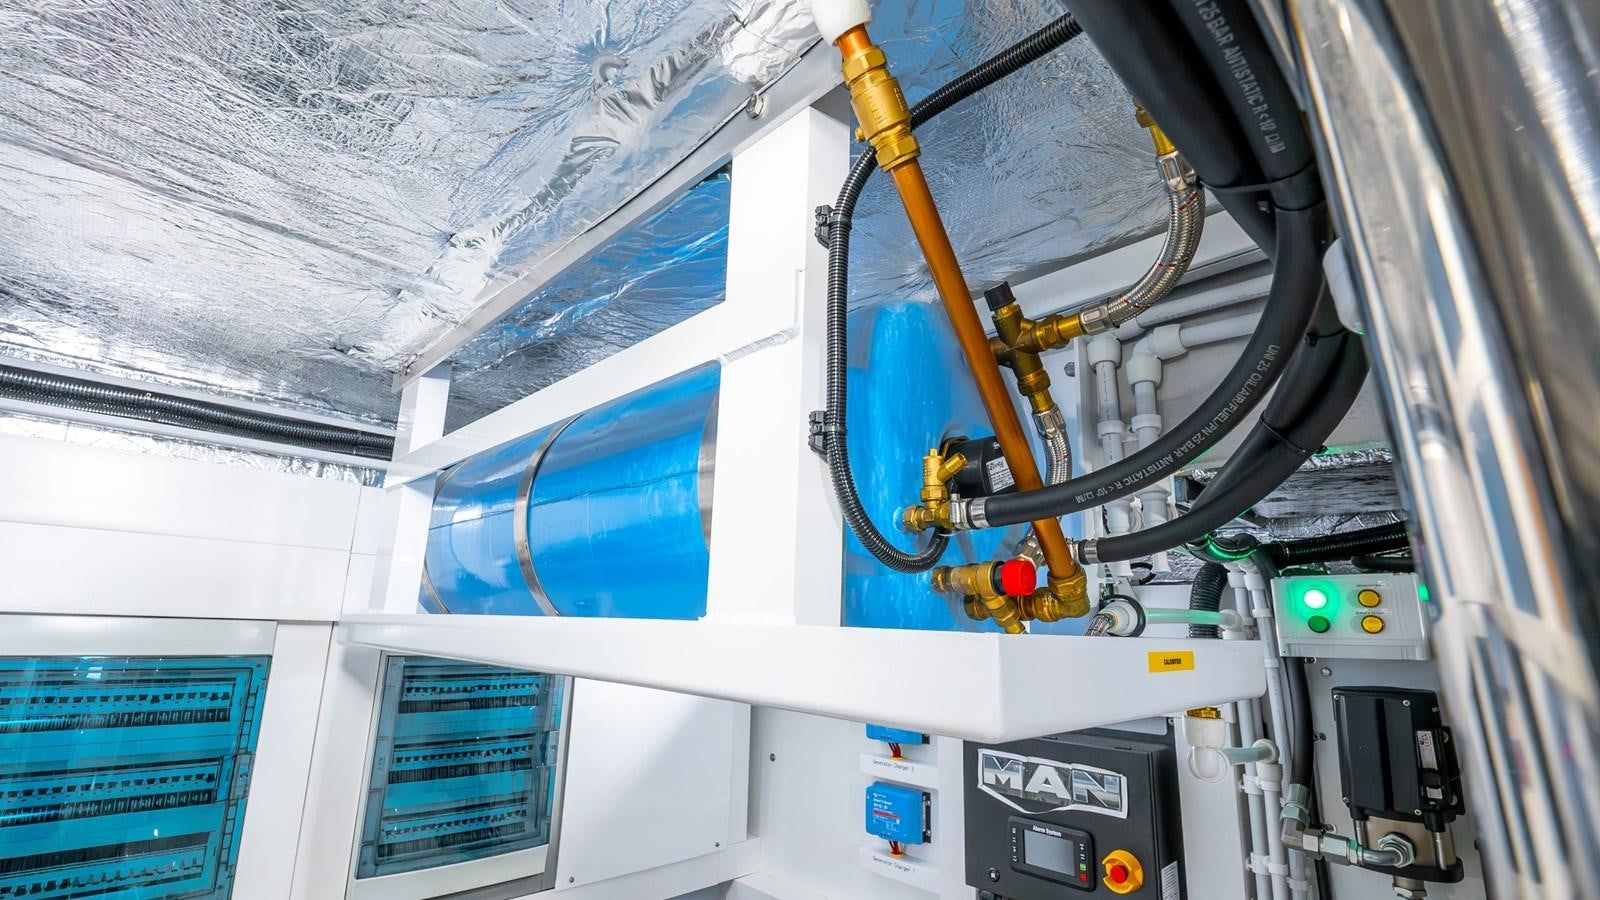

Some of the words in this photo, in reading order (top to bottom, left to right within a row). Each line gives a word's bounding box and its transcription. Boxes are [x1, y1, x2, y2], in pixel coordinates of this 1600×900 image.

[1198, 1, 1220, 20] 25
[1206, 16, 1234, 46] BAR
[1222, 46, 1265, 105] ANTISTATIC
[1263, 344, 1280, 361] UNI
[1256, 360, 1271, 373] 25
[1192, 431, 1206, 445] 25
[1174, 441, 1195, 458] BAR
[1122, 453, 1174, 486] ANTISTATIC
[983, 755, 1121, 810] MAN
[1032, 825, 1046, 833] Alarm
[1046, 827, 1062, 837] System
